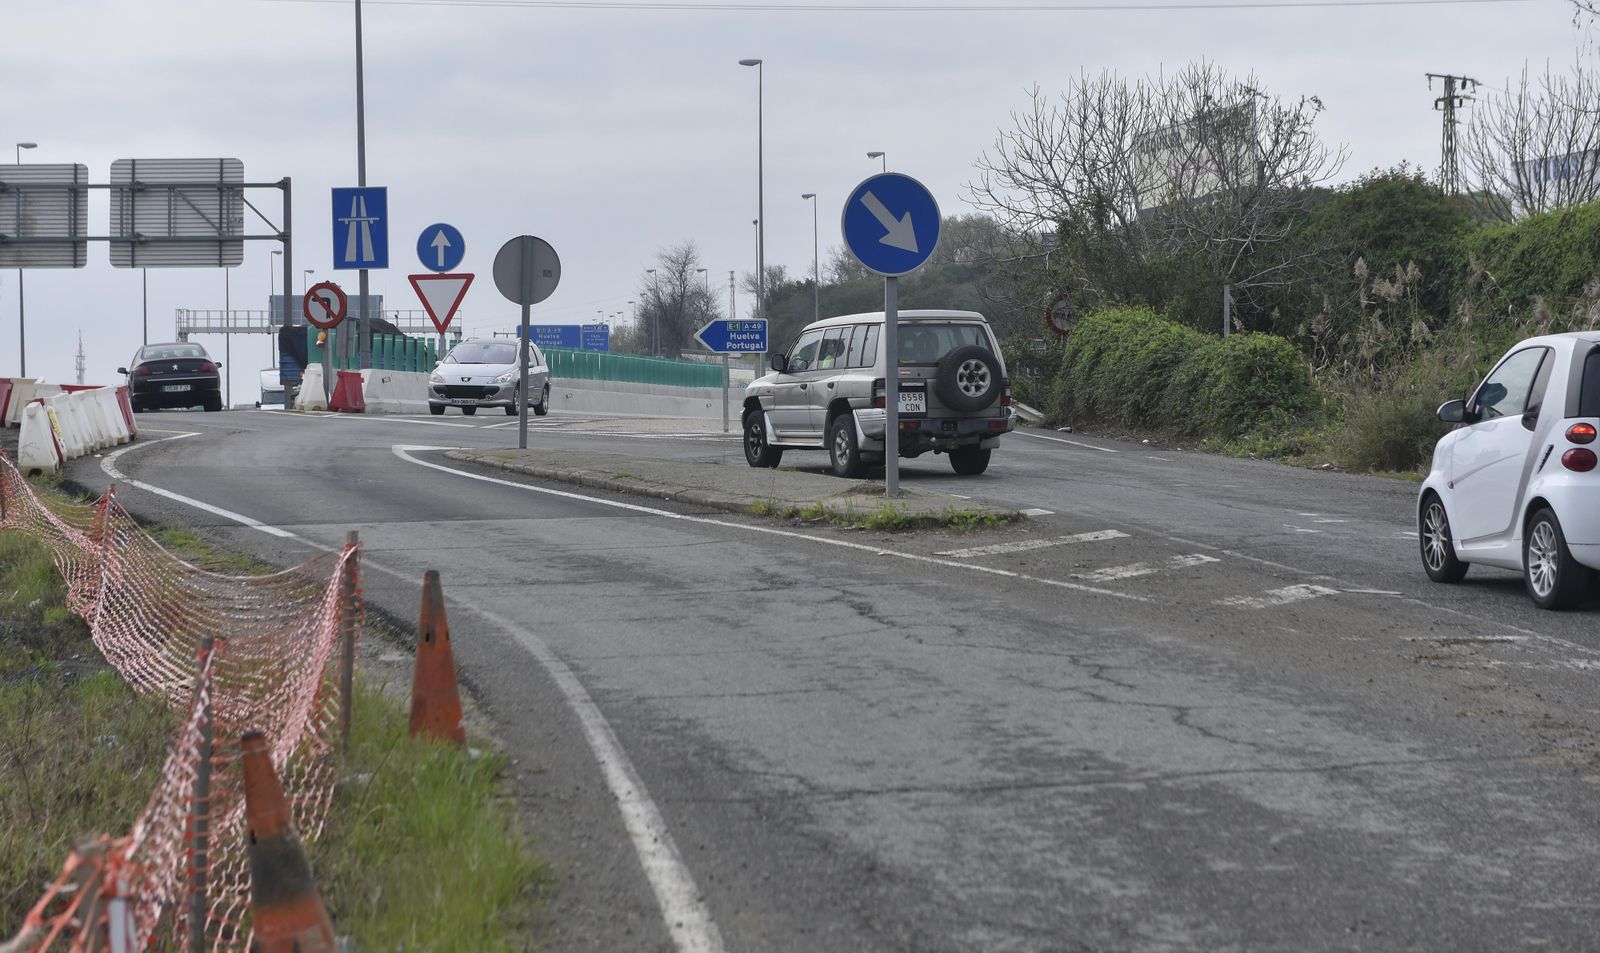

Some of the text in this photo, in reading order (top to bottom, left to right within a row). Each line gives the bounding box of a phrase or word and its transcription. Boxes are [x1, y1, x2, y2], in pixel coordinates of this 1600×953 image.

[730, 332, 760, 340] Huelva
[726, 341, 764, 350] Portugal
[901, 393, 923, 402] 6558
[905, 403, 921, 411] CDN
